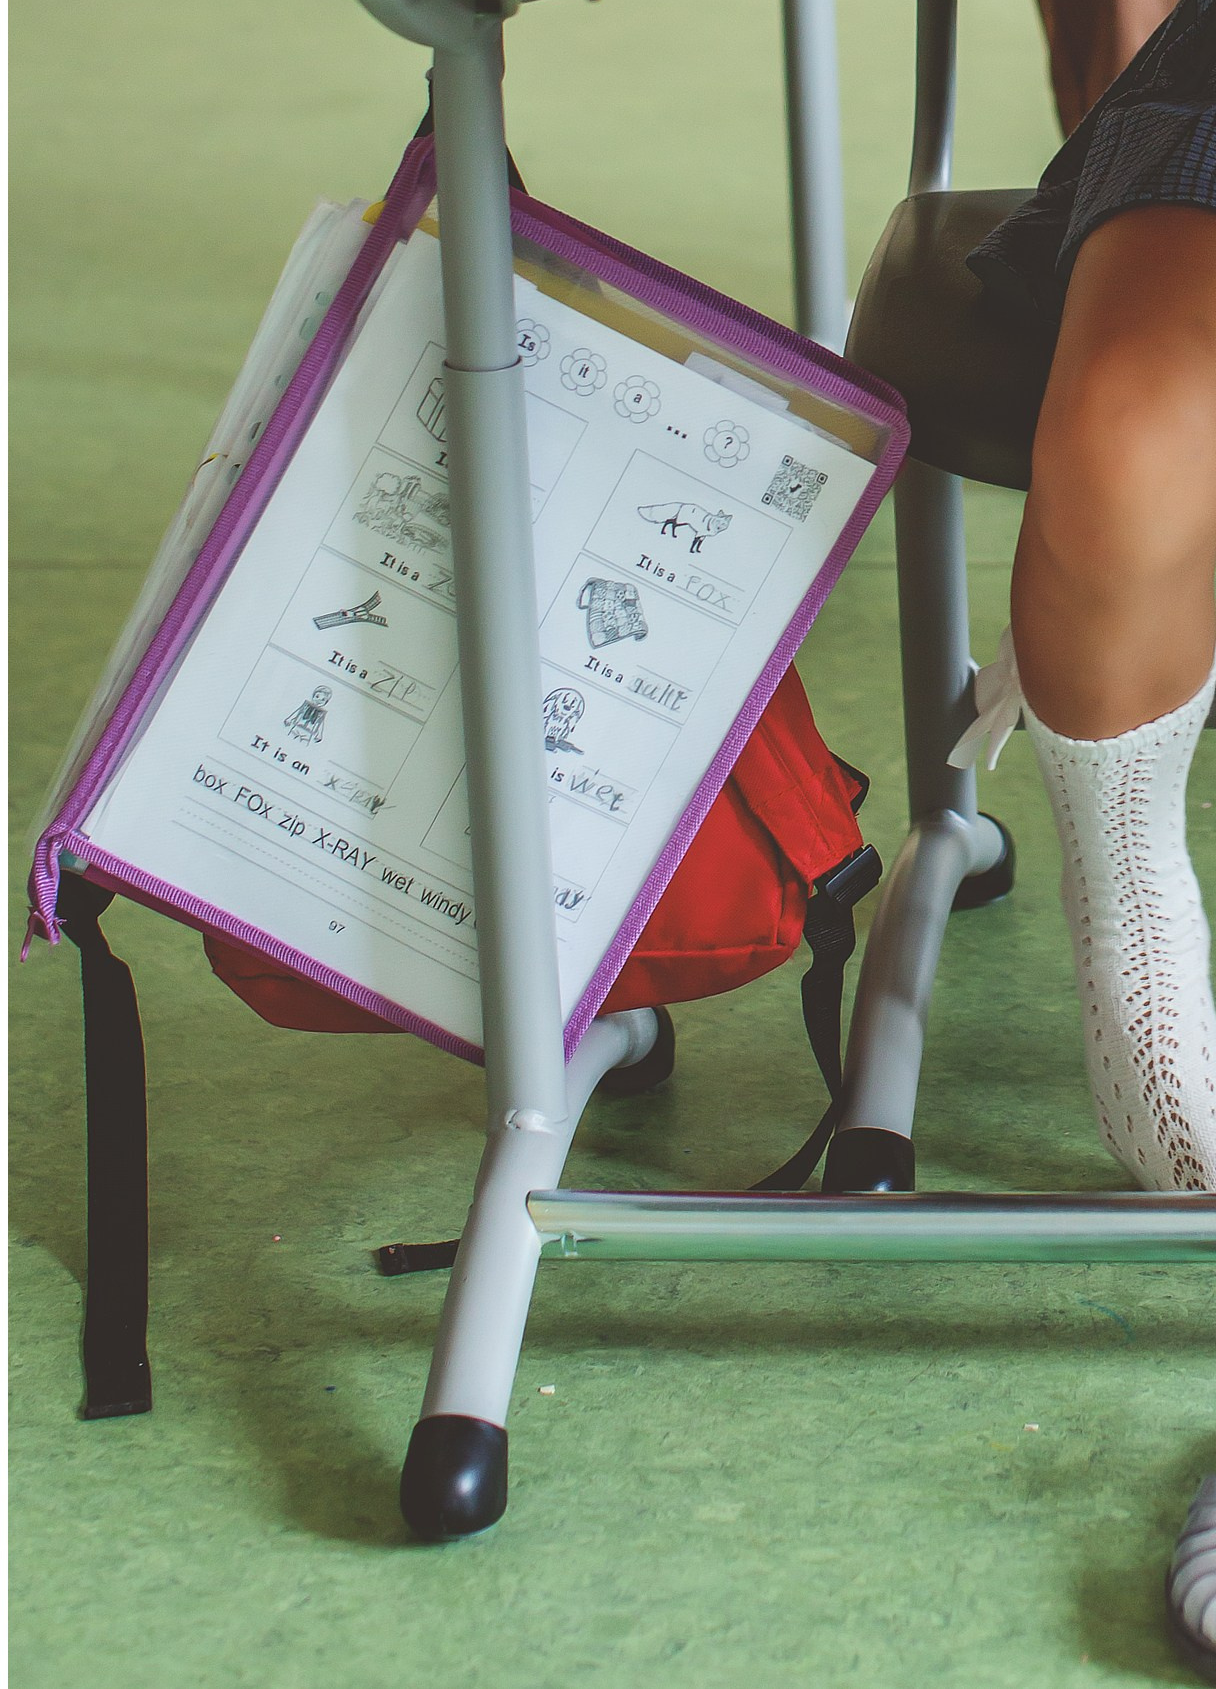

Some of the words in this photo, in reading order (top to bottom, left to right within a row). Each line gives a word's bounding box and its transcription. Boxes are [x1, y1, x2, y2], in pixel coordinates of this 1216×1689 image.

[517, 333, 536, 352] Is
[578, 364, 590, 378] it
[633, 392, 643, 404] a
[723, 436, 734, 450] ?
[379, 551, 397, 570] It
[396, 560, 410, 576] is
[410, 571, 421, 582] a
[636, 553, 653, 571] It
[653, 562, 666, 578] is
[666, 572, 676, 583] a
[328, 649, 345, 668] It
[344, 658, 358, 674] is
[359, 669, 369, 680] a
[584, 655, 601, 672] It
[600, 663, 614, 679] is
[614, 673, 624, 684] a
[250, 734, 270, 752] It
[273, 747, 288, 763] is
[291, 759, 310, 776] an
[550, 766, 565, 783] is
[192, 763, 228, 795] box
[277, 812, 306, 838] zip
[311, 827, 377, 871] X-RAY
[381, 866, 415, 895] wet
[420, 886, 472, 926] windy
[328, 920, 346, 935] 97
